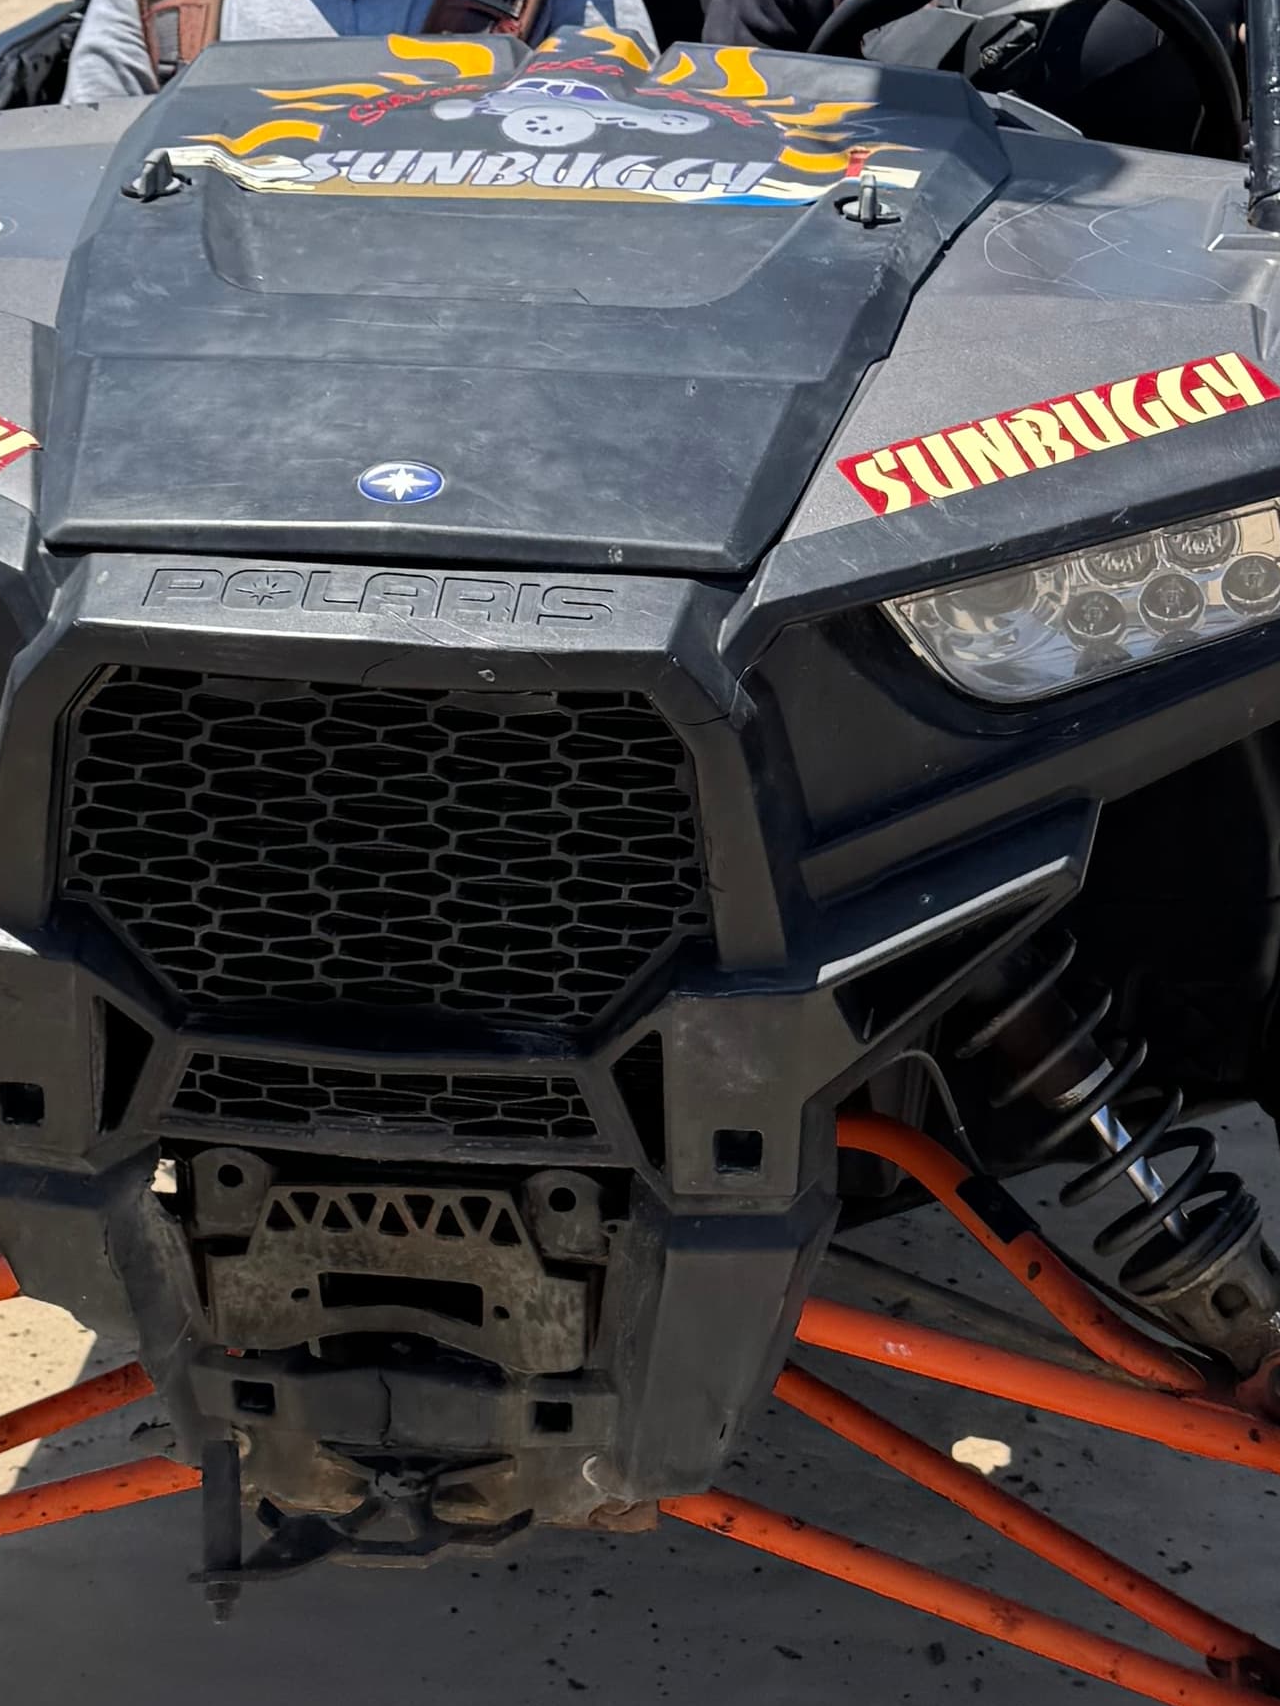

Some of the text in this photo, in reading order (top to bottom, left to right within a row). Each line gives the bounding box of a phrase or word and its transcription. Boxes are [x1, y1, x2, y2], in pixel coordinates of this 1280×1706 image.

[301, 149, 776, 193] SUNBUGGY
[854, 351, 1267, 515] SUNBUGGY
[141, 567, 616, 627] POLARIS
